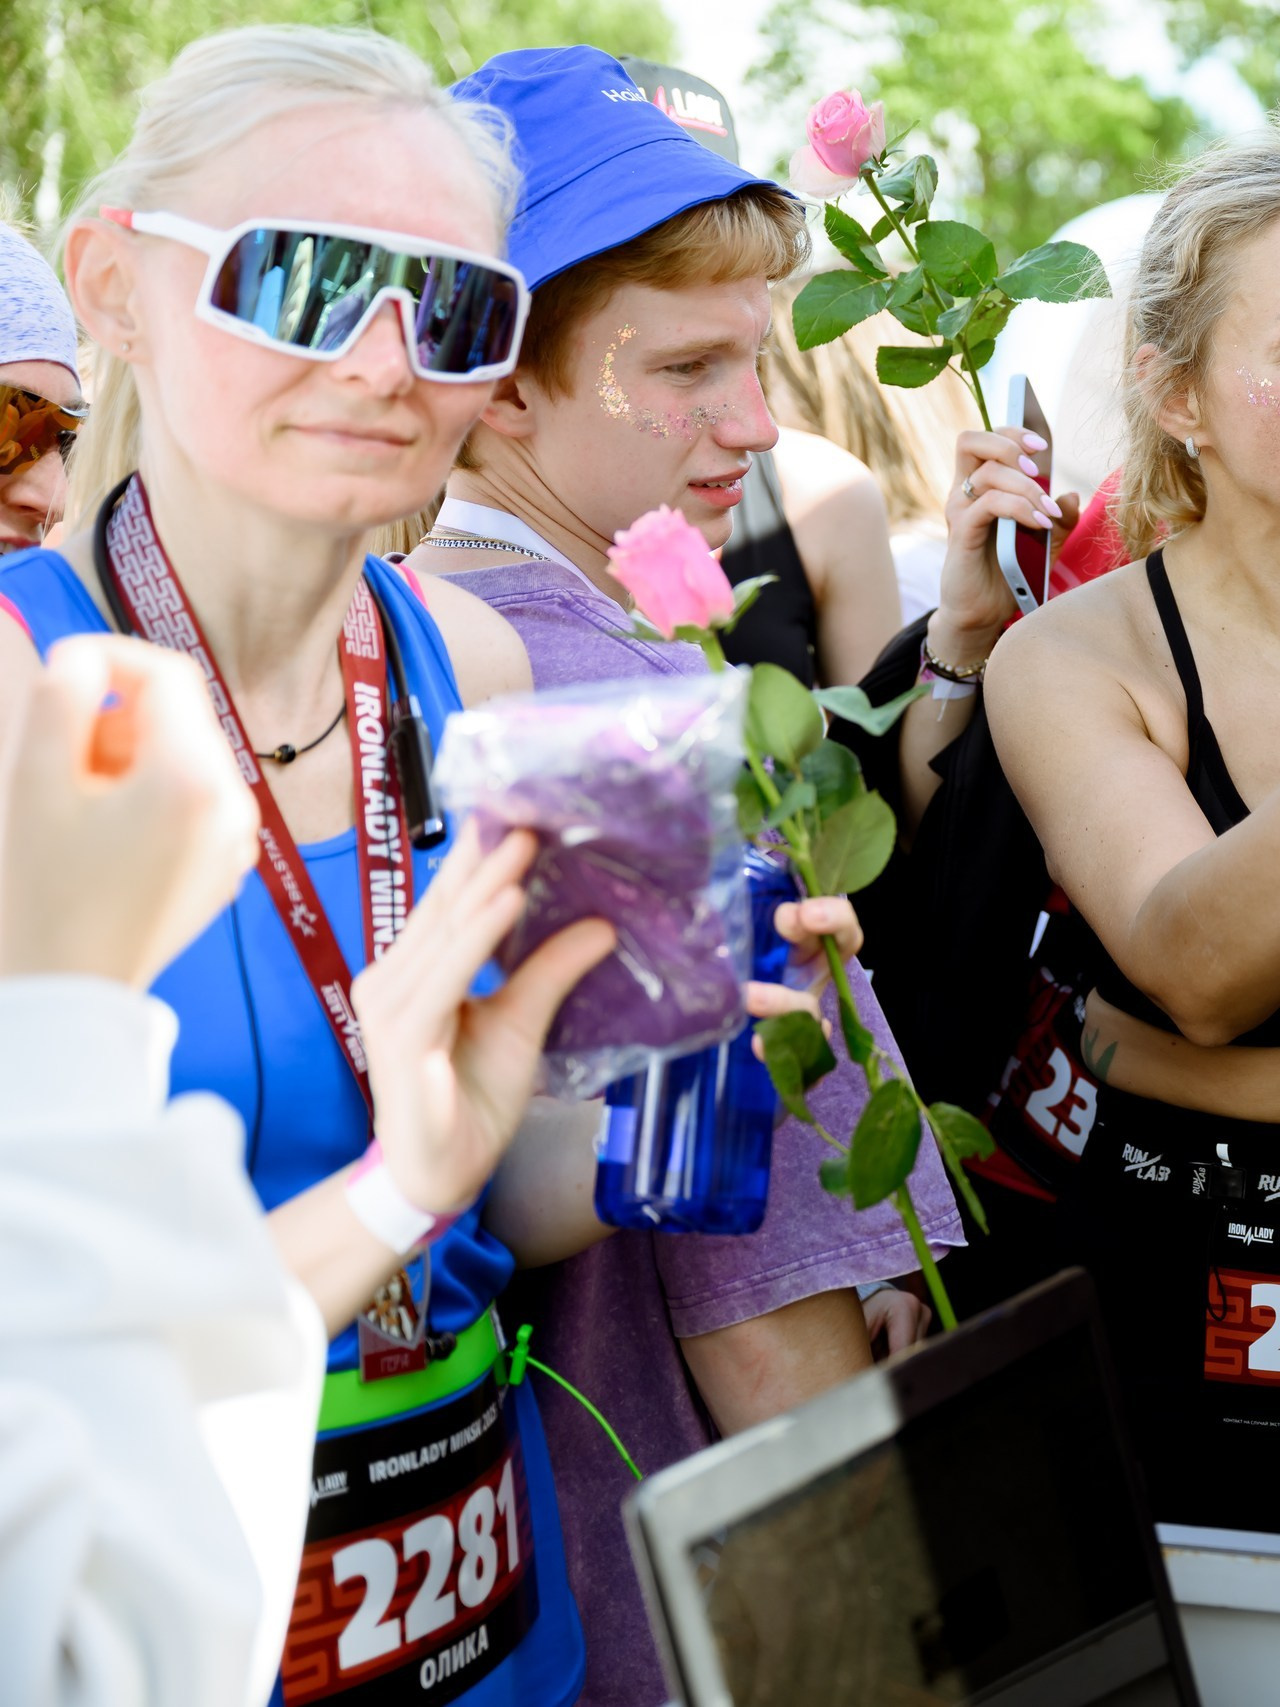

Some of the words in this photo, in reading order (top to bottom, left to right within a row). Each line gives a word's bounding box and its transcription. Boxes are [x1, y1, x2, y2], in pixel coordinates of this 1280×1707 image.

[352, 681, 404, 863] IRONLADY
[1024, 1046, 1098, 1157] 23
[1121, 1143, 1150, 1164] RUN
[1228, 1222, 1247, 1236] IRON
[1253, 1226, 1275, 1240] LADY
[368, 1438, 450, 1484] IRONLADY
[450, 1420, 482, 1454] MINSK
[332, 1457, 520, 1671] 2281
[419, 1624, 490, 1690] ОЛИКА
